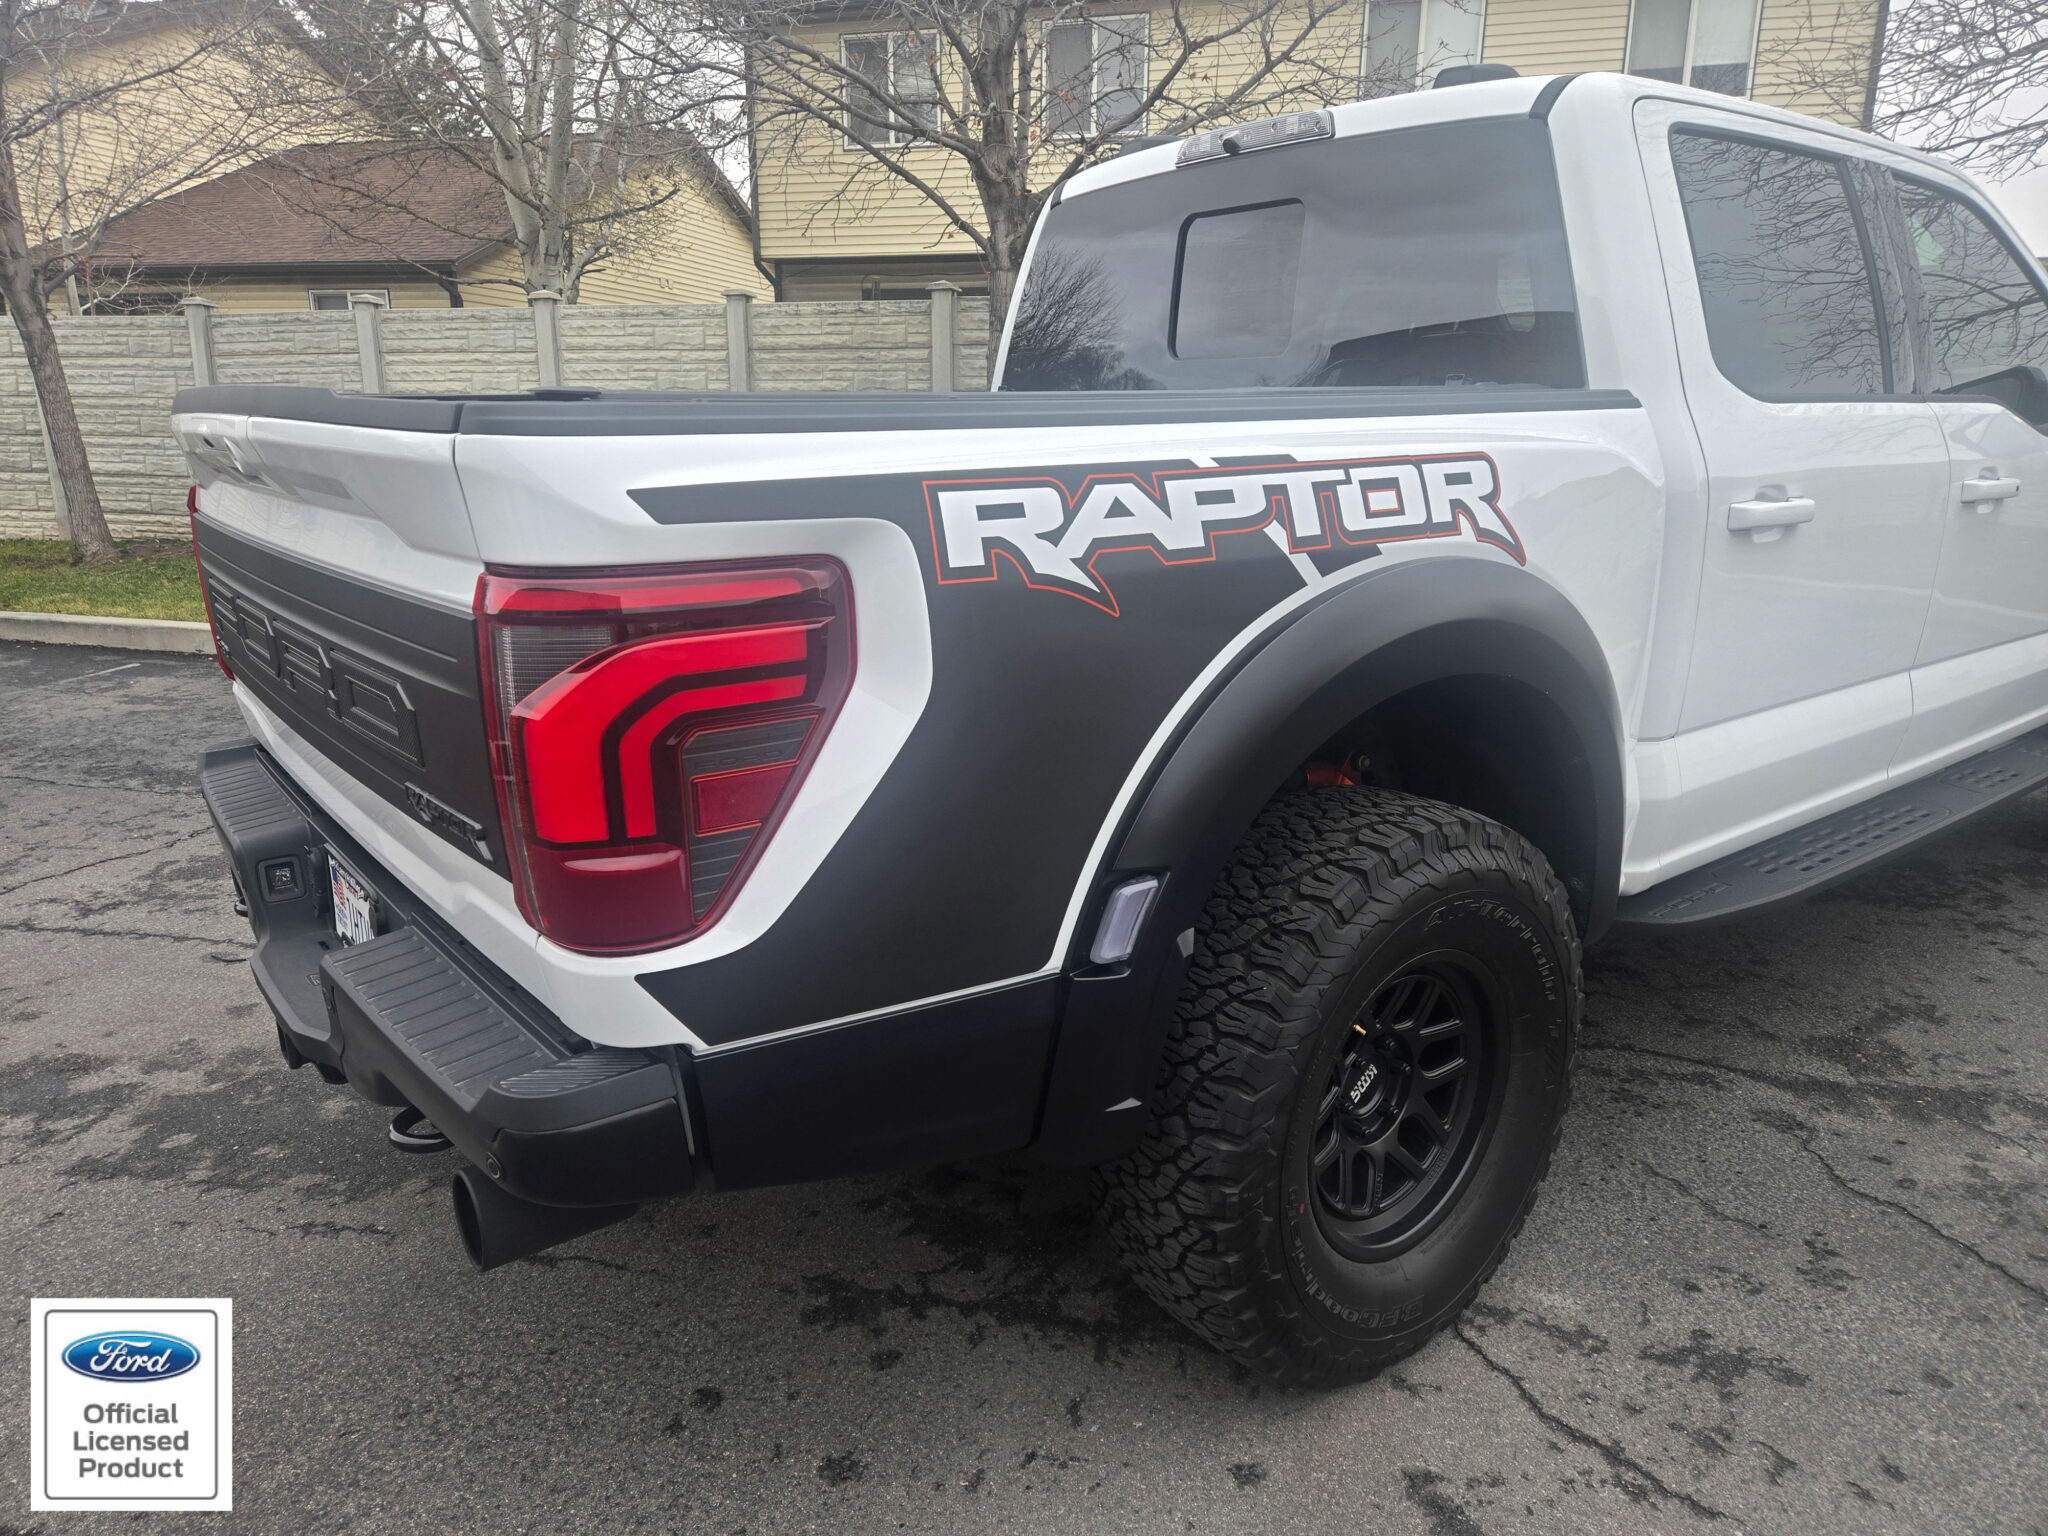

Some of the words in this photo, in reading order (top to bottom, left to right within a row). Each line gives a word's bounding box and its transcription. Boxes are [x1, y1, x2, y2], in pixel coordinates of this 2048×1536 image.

[926, 453, 1524, 608] RAPTOR
[208, 577, 426, 769] FORD
[404, 781, 495, 864] RAPTOR
